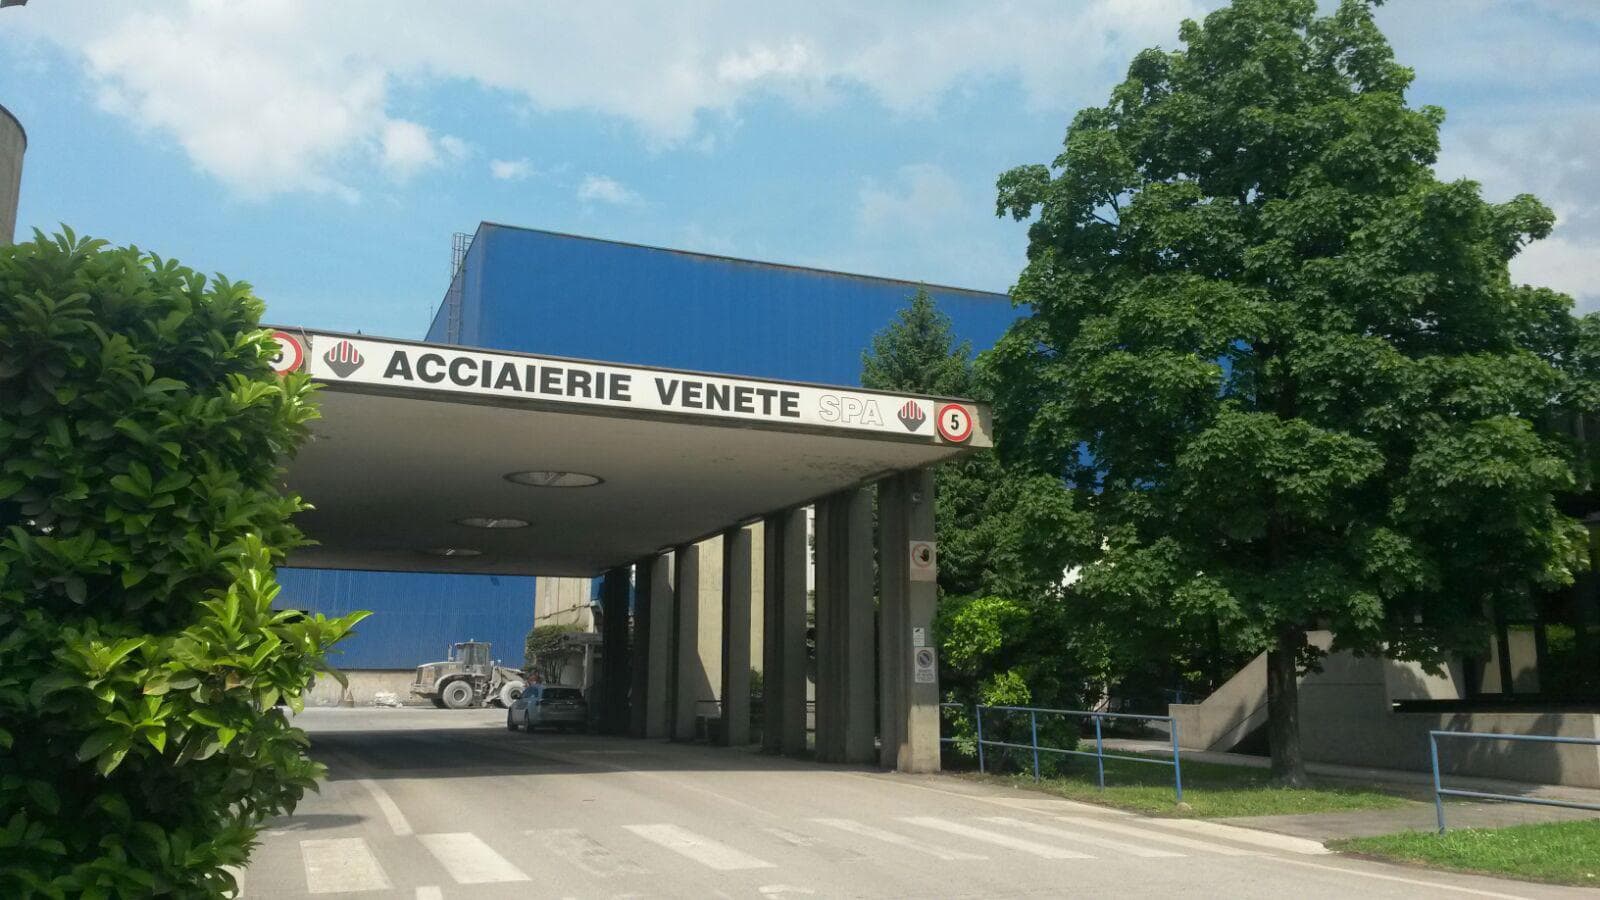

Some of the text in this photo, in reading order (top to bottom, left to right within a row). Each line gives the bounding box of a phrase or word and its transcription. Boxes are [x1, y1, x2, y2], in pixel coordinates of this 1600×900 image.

[383, 350, 885, 426] ACCIAIERIE VENETE SPA
[950, 414, 960, 431] 5
